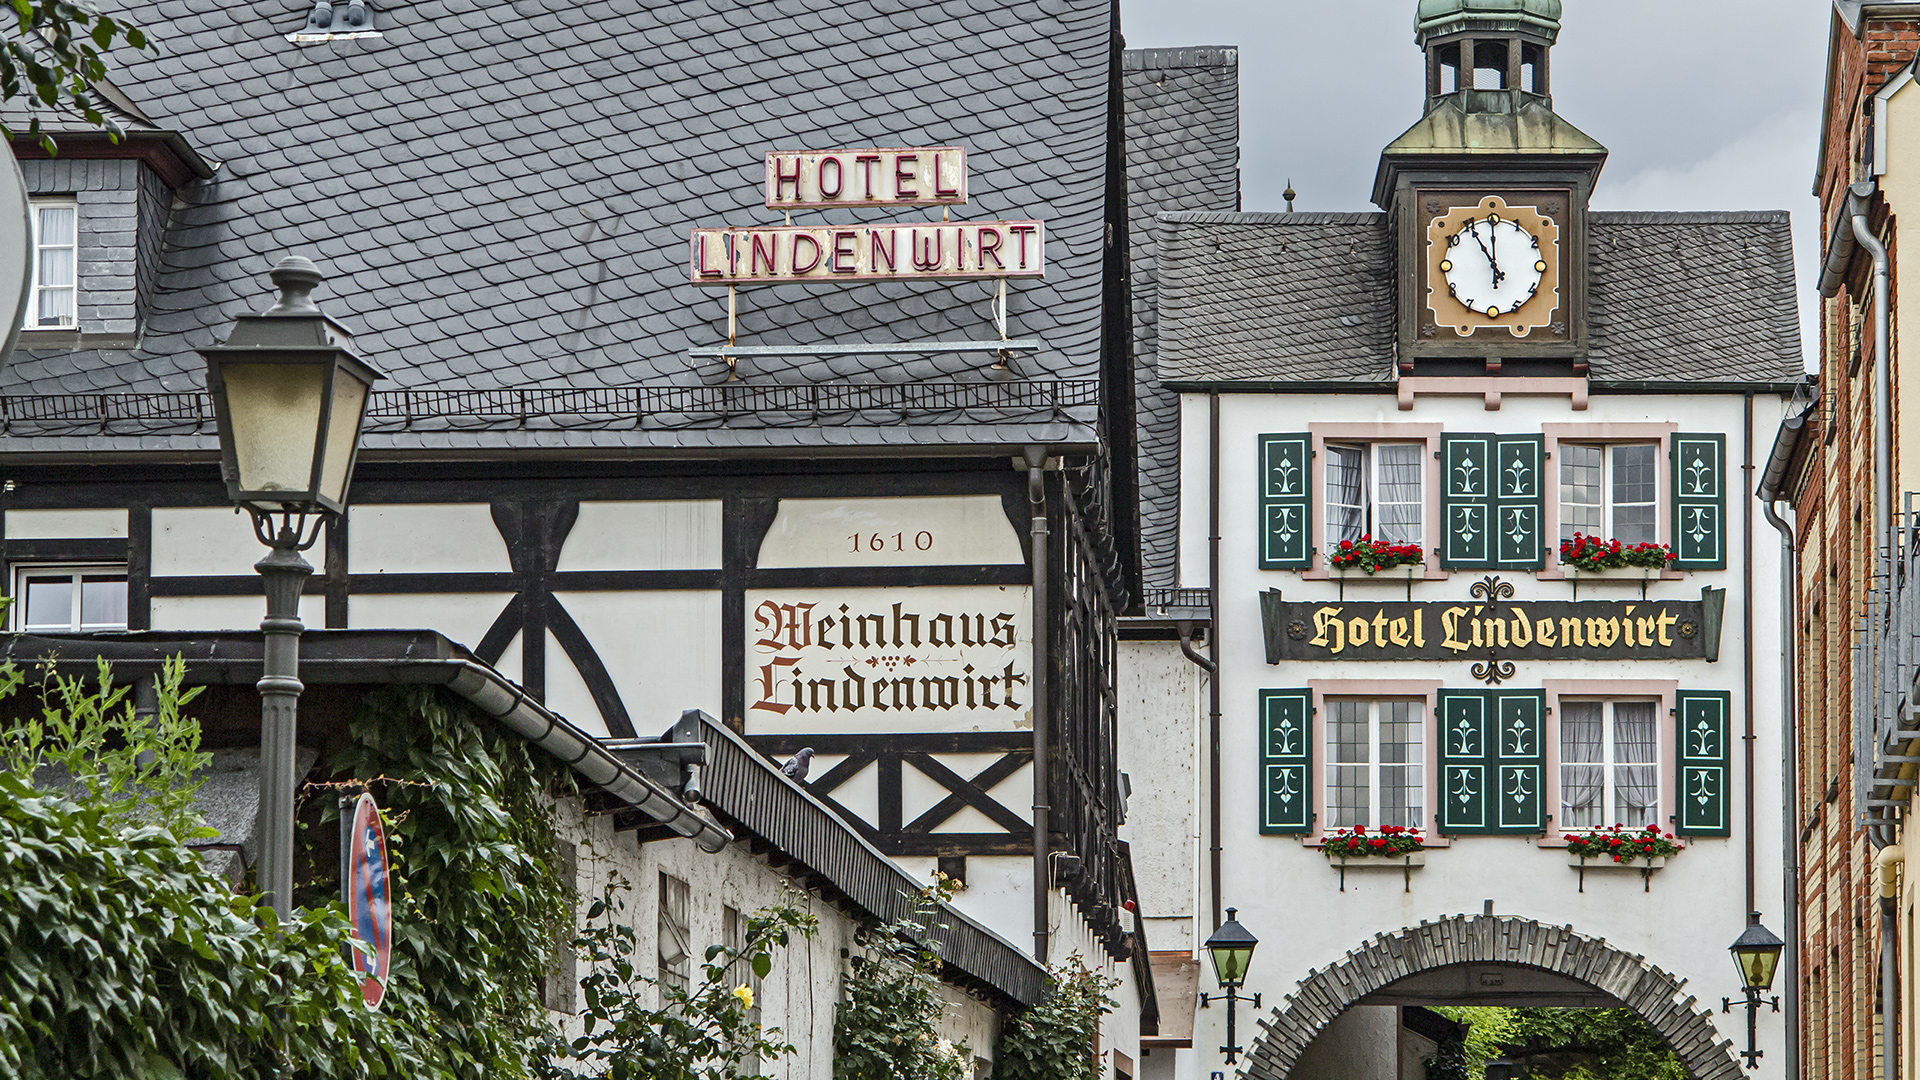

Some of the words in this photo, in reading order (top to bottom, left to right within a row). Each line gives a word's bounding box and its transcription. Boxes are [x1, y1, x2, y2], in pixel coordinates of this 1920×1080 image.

[775, 153, 959, 201] HOTEL
[1512, 219, 1520, 232] 1
[1445, 234, 1460, 248] 10
[1530, 235, 1539, 249] 2
[698, 225, 1036, 277] LINDENWIRT
[1448, 282, 1457, 297] 8
[1528, 282, 1538, 297] 4
[1466, 299, 1475, 312] 7
[1510, 300, 1522, 313] 5
[847, 530, 933, 553] 1610
[753, 599, 1017, 653] Weinhaus
[1308, 605, 1426, 654] Hotel
[1440, 605, 1679, 653] Lindenwirt
[750, 655, 1026, 715] Lindenwirt
